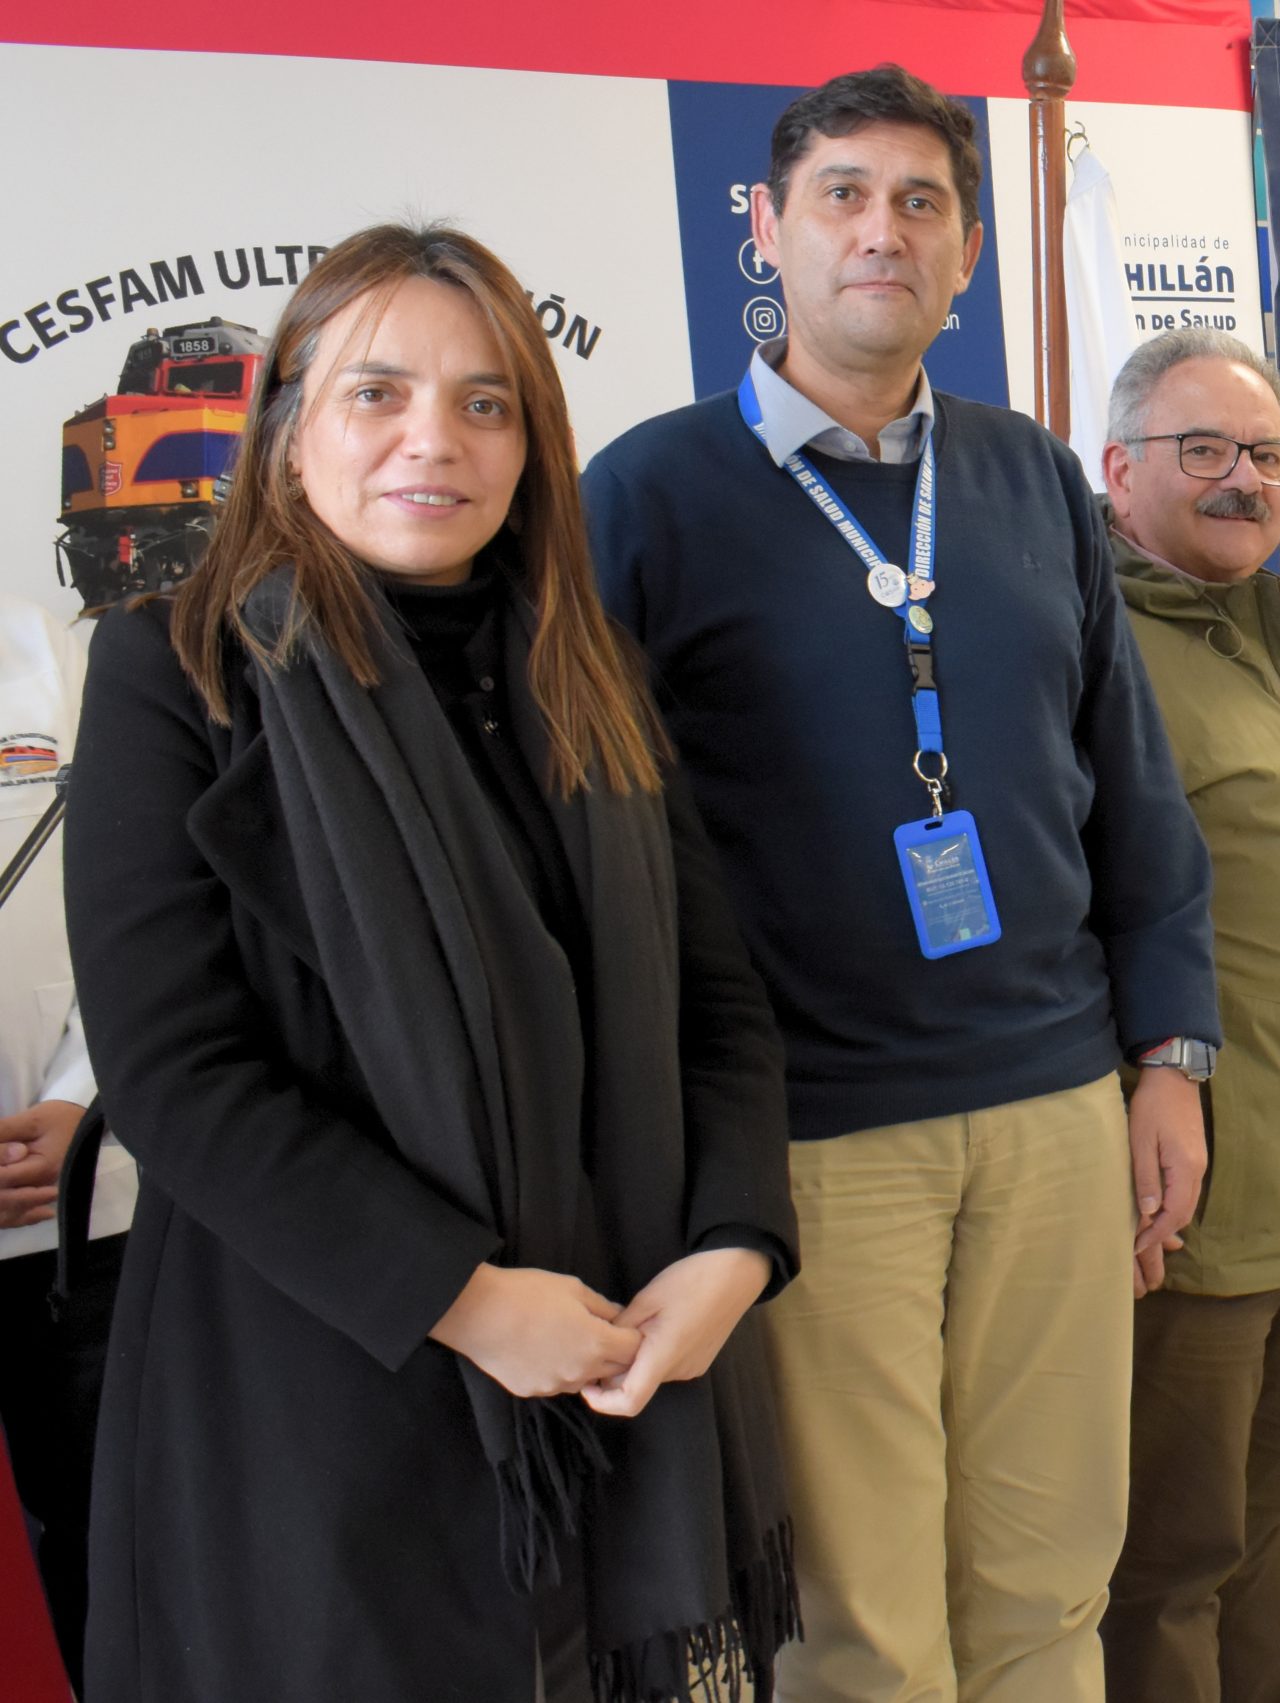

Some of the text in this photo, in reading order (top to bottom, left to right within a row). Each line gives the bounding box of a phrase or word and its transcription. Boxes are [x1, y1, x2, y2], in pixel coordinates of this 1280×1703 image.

[1125, 233, 1229, 250] nicipalidad de
[1125, 256, 1235, 293] HILLán
[0, 255, 205, 364] CESFAM
[180, 340, 209, 352] 1858
[796, 470, 817, 487] DE
[809, 484, 845, 521] SALUD
[919, 499, 931, 515] DE
[914, 514, 931, 578] DIRECCIÓN
